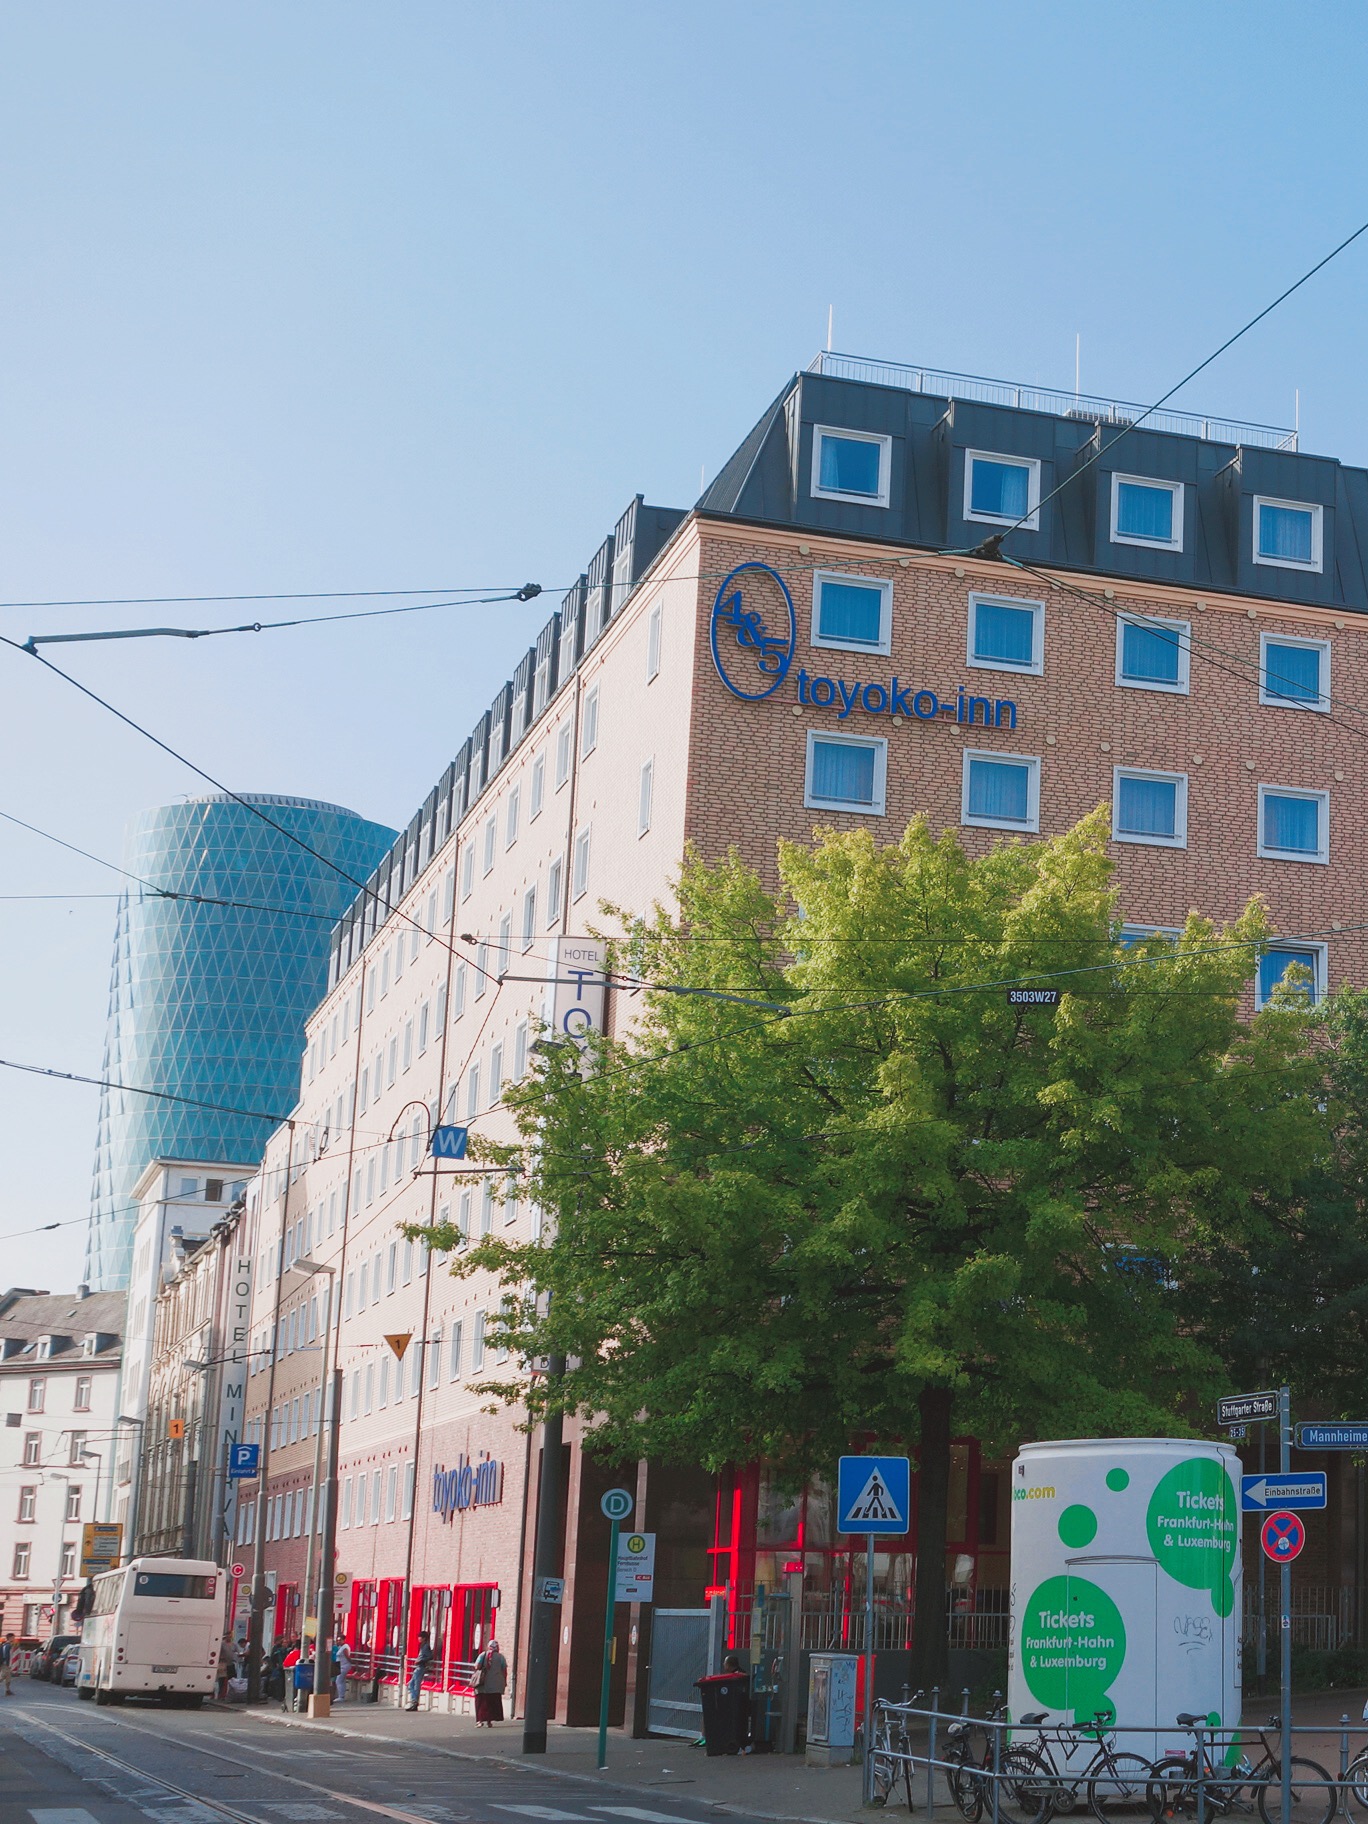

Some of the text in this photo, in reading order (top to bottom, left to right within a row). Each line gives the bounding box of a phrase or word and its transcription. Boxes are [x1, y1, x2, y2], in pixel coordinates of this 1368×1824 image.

[797, 668, 1017, 729] toyoko-inn
[565, 949, 599, 961] HOTEL
[1010, 991, 1057, 1003] 3503W27
[437, 1131, 464, 1154] W
[232, 1260, 251, 1364] HOTEL
[395, 1340, 400, 1349] 1
[1221, 1400, 1273, 1417] Stuttgarter Straße
[173, 1424, 179, 1434] 1
[238, 1451, 250, 1465] P
[1264, 1485, 1321, 1497] Einbahnstraße
[610, 1496, 625, 1513] D
[1176, 1491, 1224, 1511] Tickets
[1157, 1515, 1234, 1531] Frankfurt-Hahn
[1164, 1534, 1231, 1552] & Luxemburg
[1038, 1610, 1095, 1629] Tickets
[1026, 1636, 1114, 1649] Frankfurt-Hahn
[1029, 1655, 1037, 1668] &
[1040, 1655, 1106, 1670] Luxemburg
